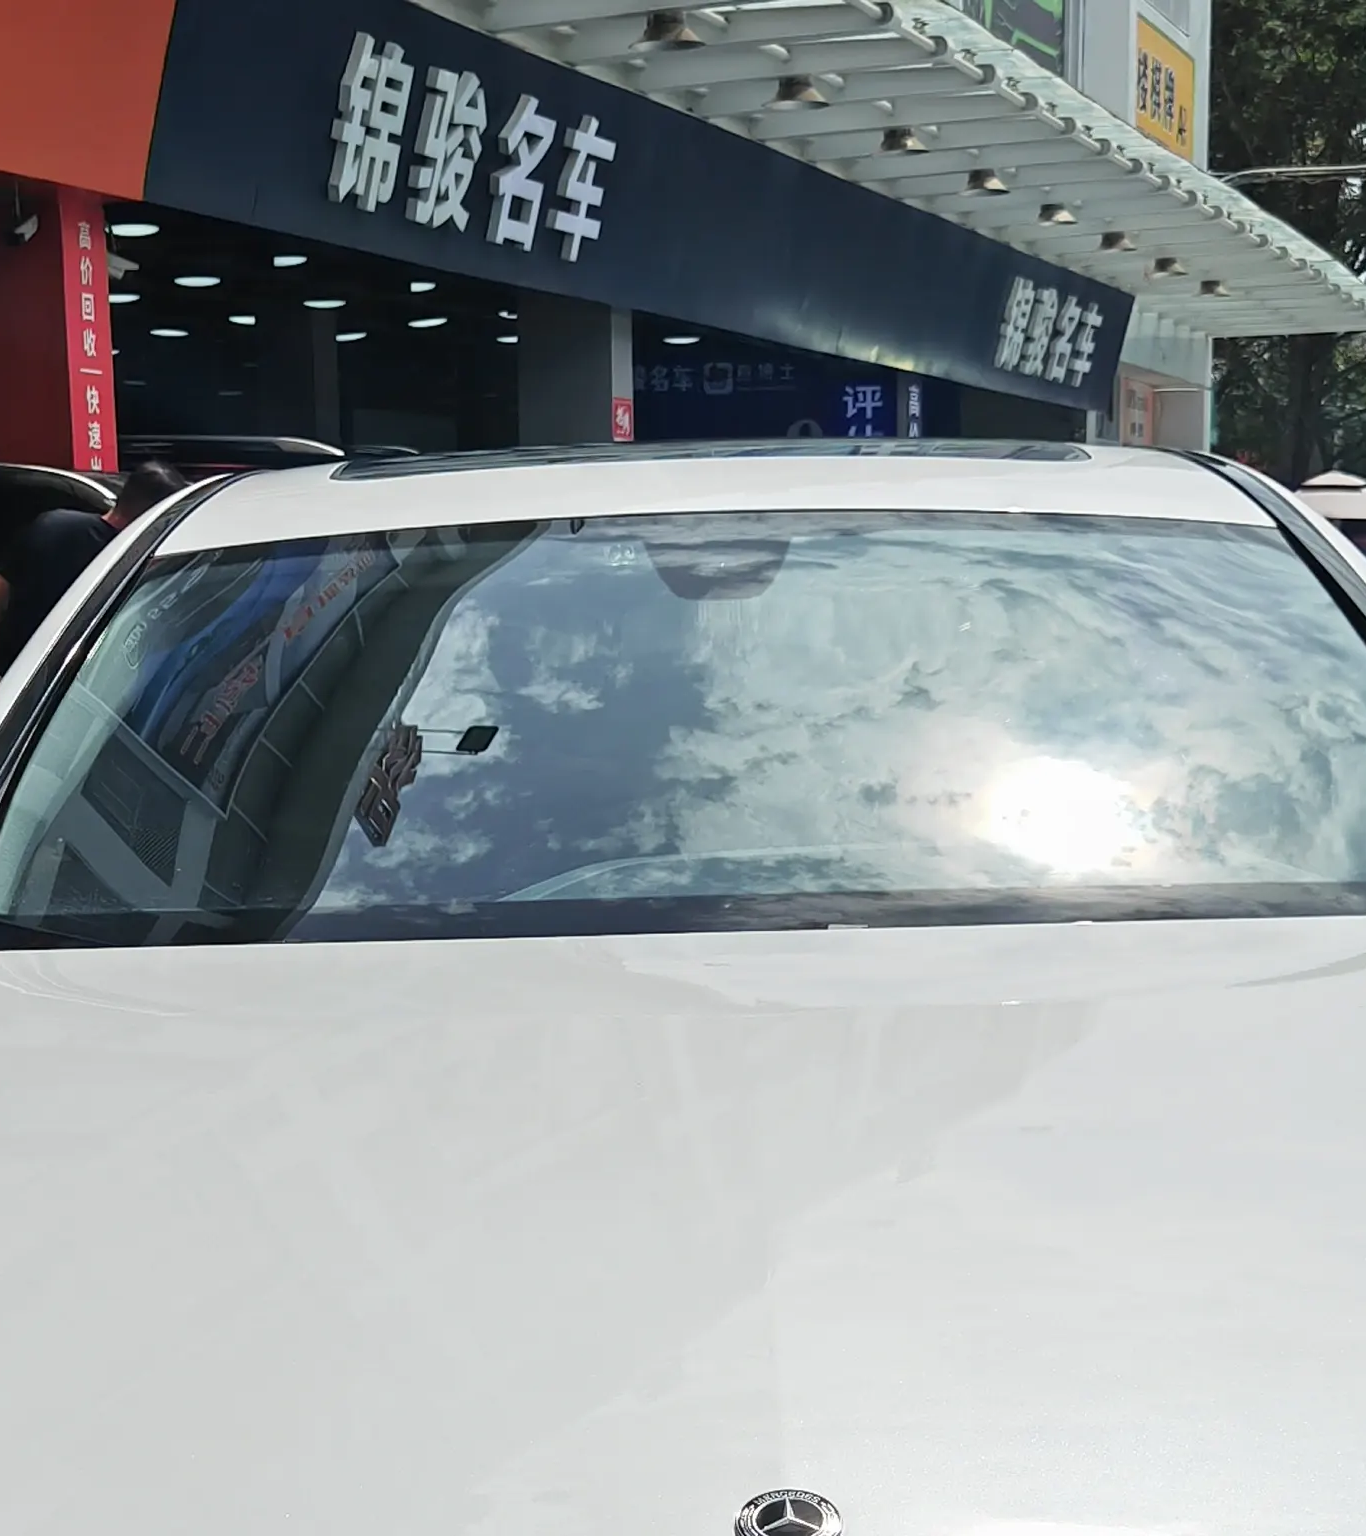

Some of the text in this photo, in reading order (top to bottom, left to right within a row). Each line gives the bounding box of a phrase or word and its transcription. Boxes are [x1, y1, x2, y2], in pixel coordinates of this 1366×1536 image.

[328, 31, 616, 262] 锦骏名车
[994, 276, 1103, 388] 锦骏名车
